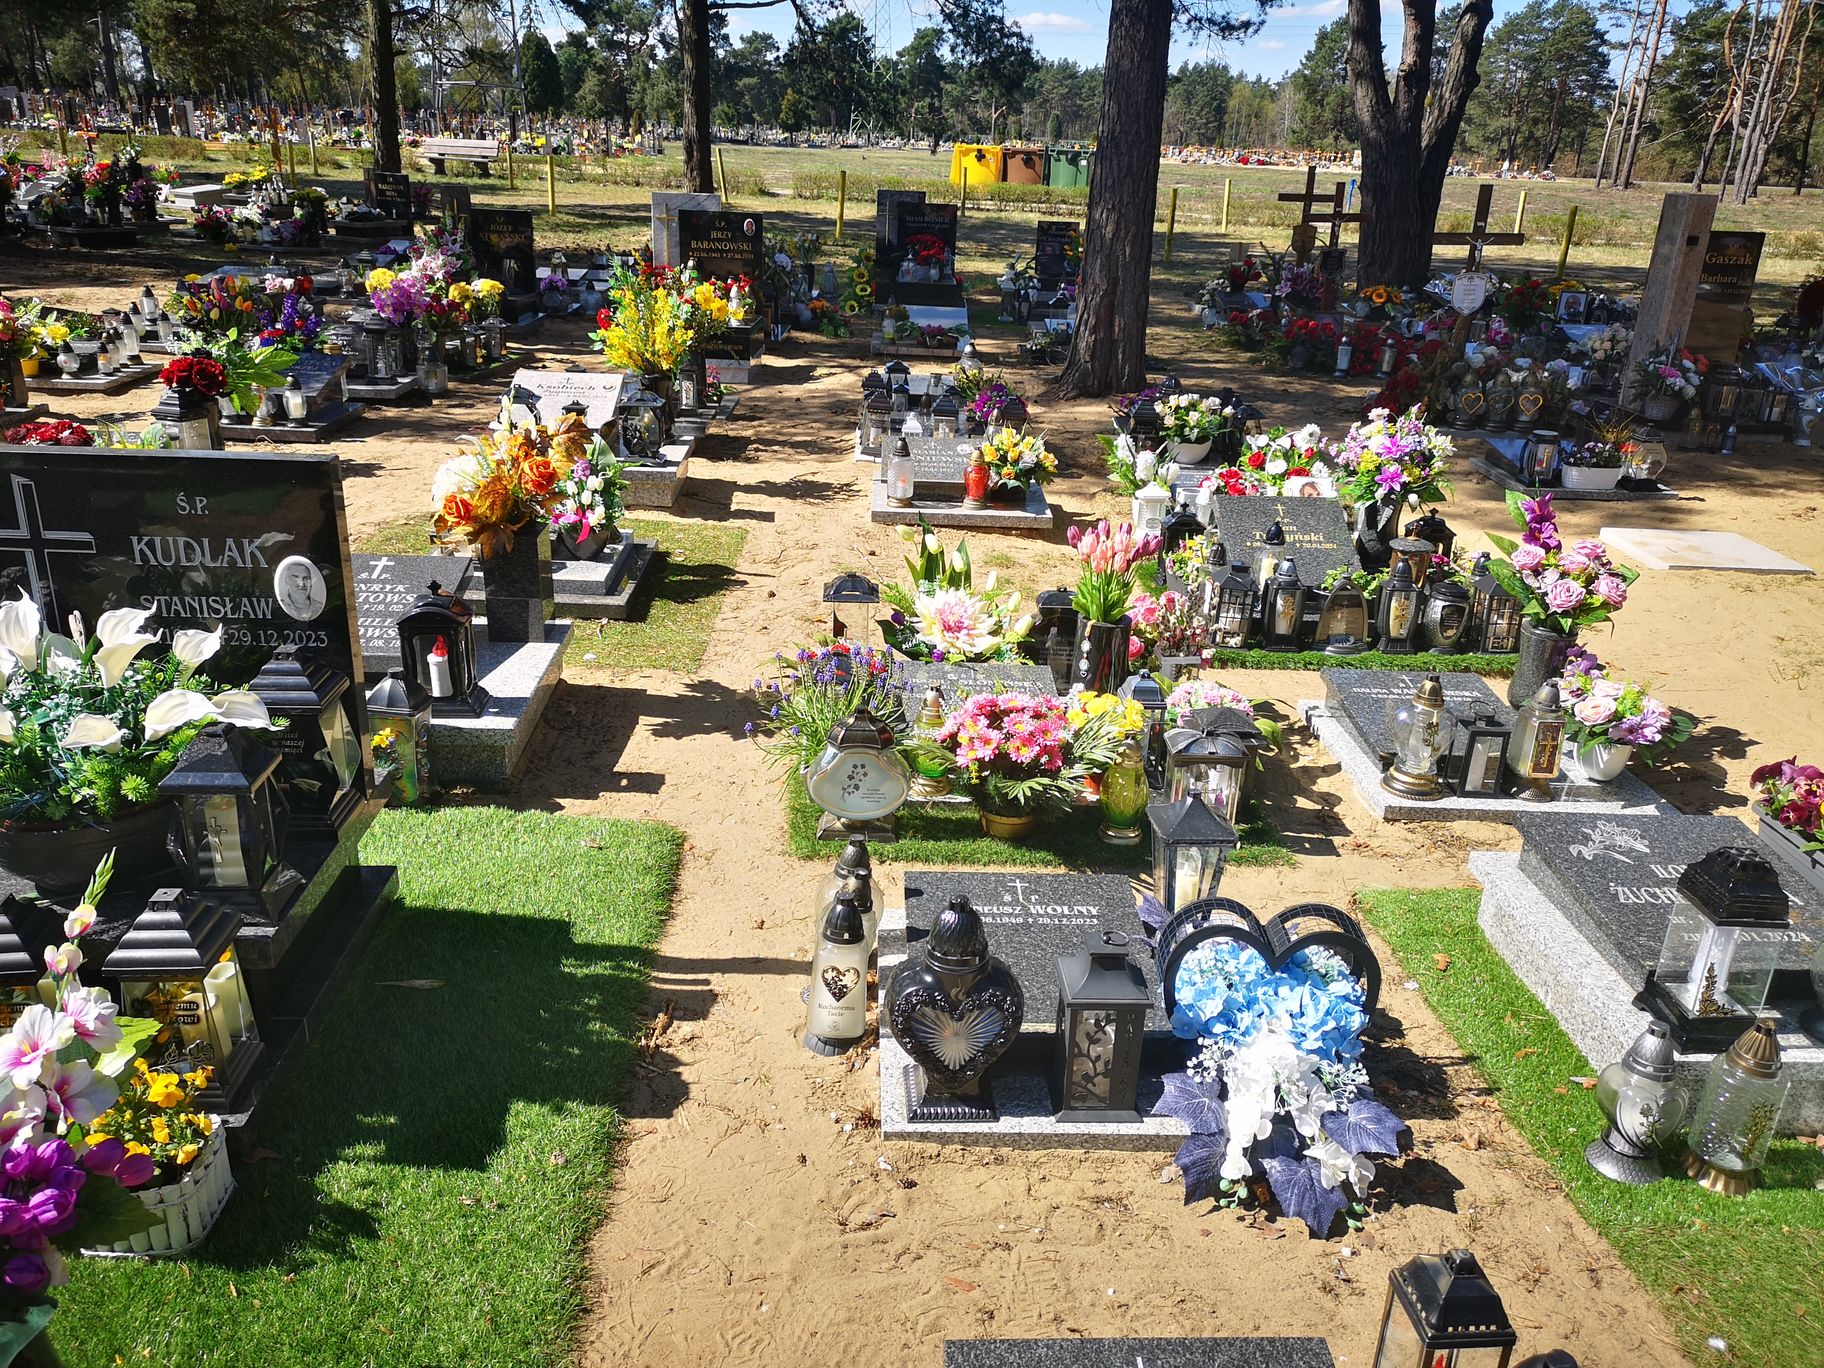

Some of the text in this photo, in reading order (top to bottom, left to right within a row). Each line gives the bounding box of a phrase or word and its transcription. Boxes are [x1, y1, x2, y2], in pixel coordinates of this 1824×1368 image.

[710, 230, 733, 239] JERZY
[691, 240, 752, 251] BARANOWSKI
[1705, 252, 1753, 265] Gaszak
[1701, 273, 1738, 283] Barbara
[176, 491, 209, 515] Ś.P.
[129, 535, 269, 568] KUDLAK
[139, 595, 274, 620] STANISŁAW
[229, 630, 329, 648] 29.12.2023
[1029, 905, 1101, 916] WOLNY
[817, 1002, 856, 1011] Kochanemu
